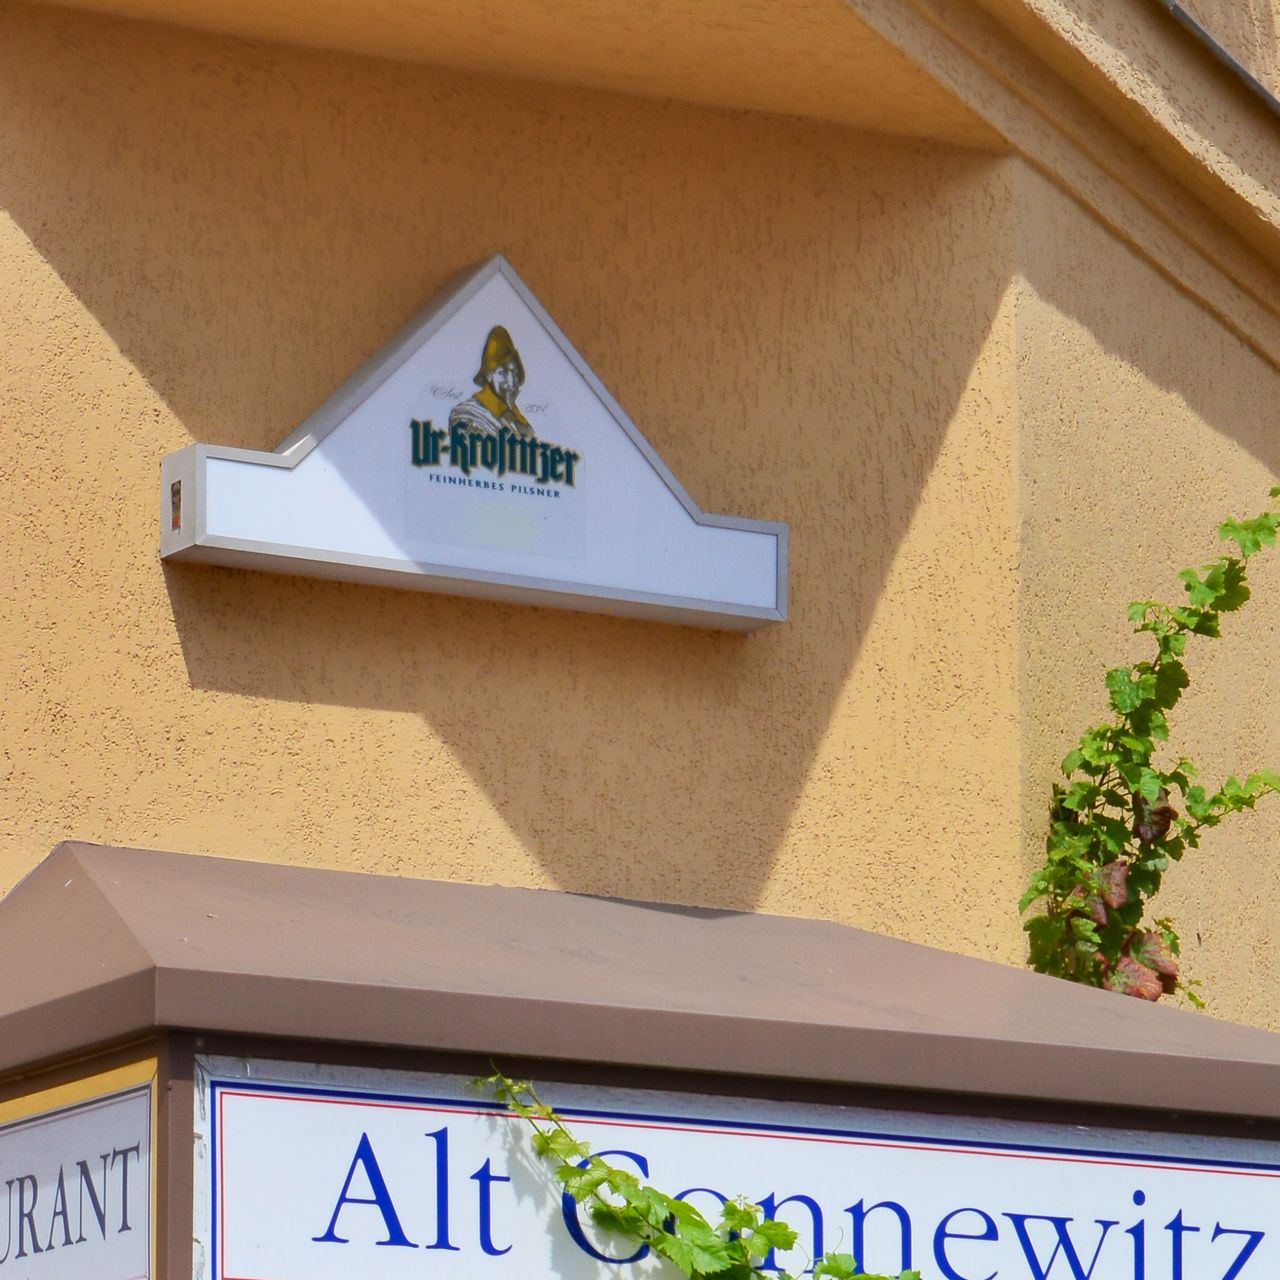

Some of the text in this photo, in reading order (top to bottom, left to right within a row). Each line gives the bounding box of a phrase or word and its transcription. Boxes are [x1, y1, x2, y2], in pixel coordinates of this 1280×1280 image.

[429, 473, 561, 498] FEINHERBES PILSNER
[311, 1126, 513, 1256] Alt
